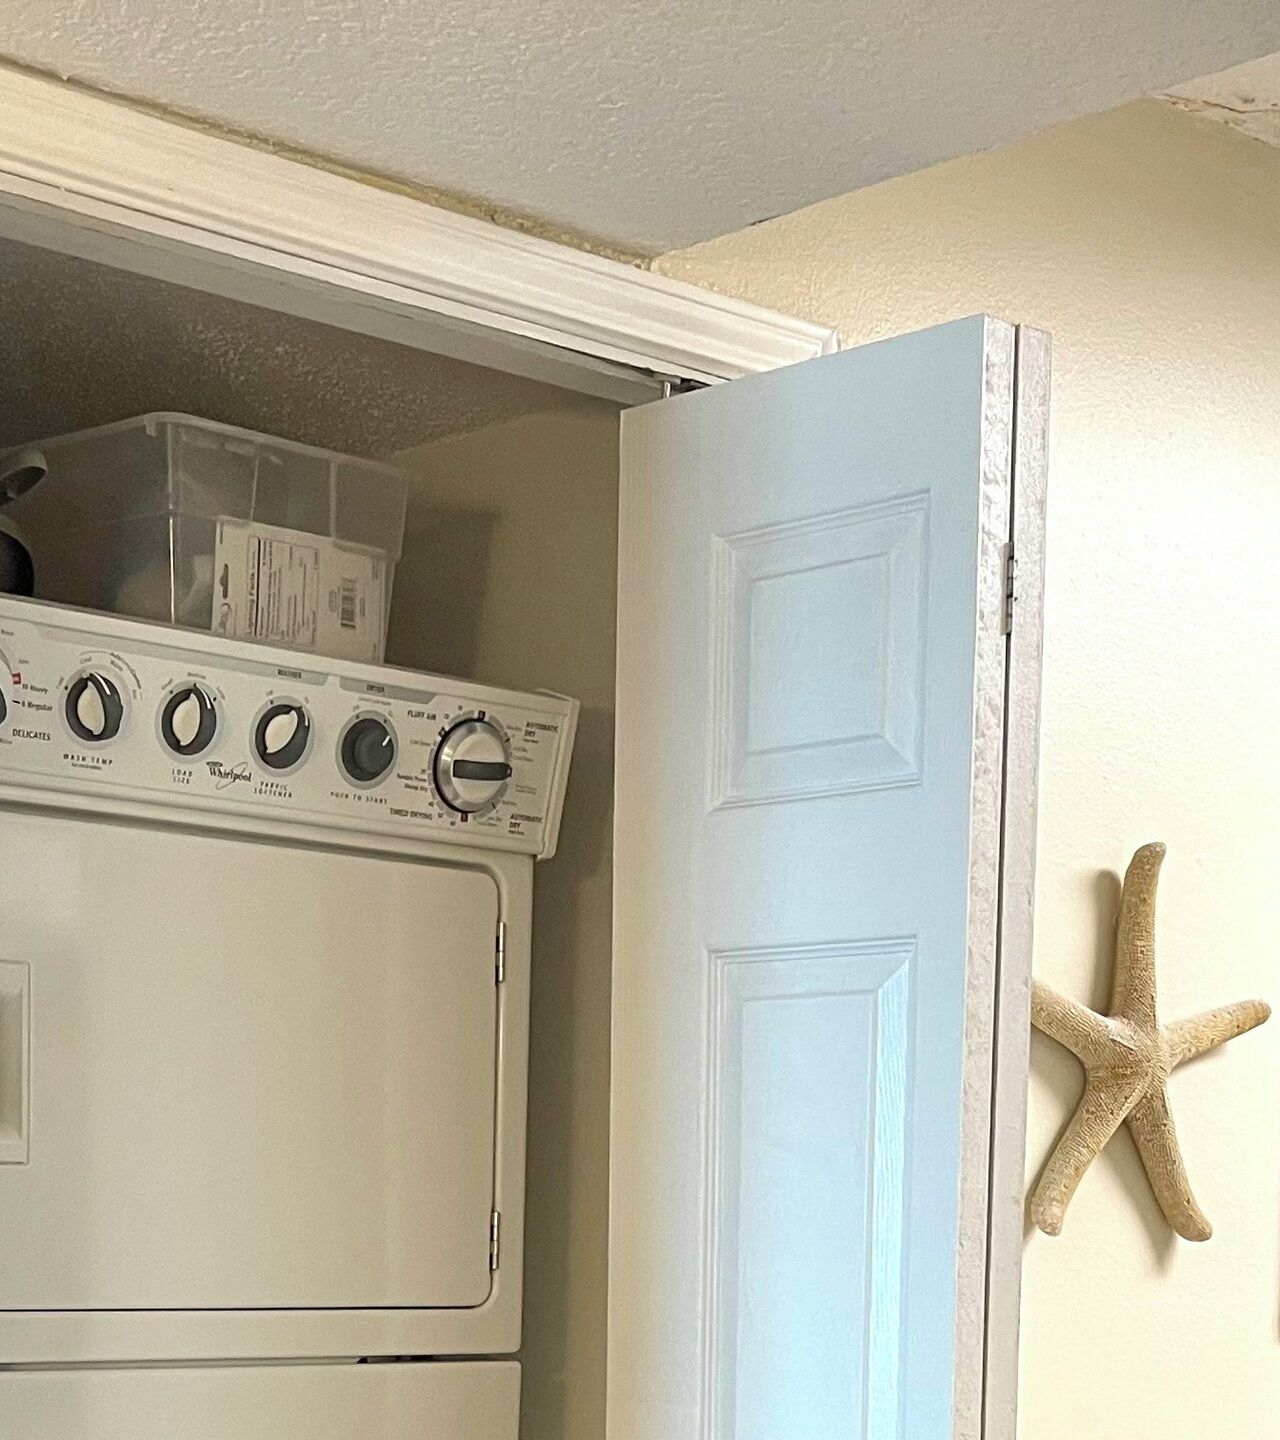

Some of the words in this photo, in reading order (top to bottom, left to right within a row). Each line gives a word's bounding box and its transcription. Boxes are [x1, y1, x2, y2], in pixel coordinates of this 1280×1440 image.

[407, 709, 426, 720] FLUFF
[426, 712, 437, 721] AIR
[12, 728, 52, 742] DELICATES
[524, 728, 536, 738] DRY
[91, 757, 113, 765] TEMP
[172, 768, 193, 777] LOAD
[208, 765, 252, 783] Whirlpool
[173, 776, 191, 785] SIZE
[253, 787, 293, 798] SOFTENER
[509, 821, 521, 830] DRY
